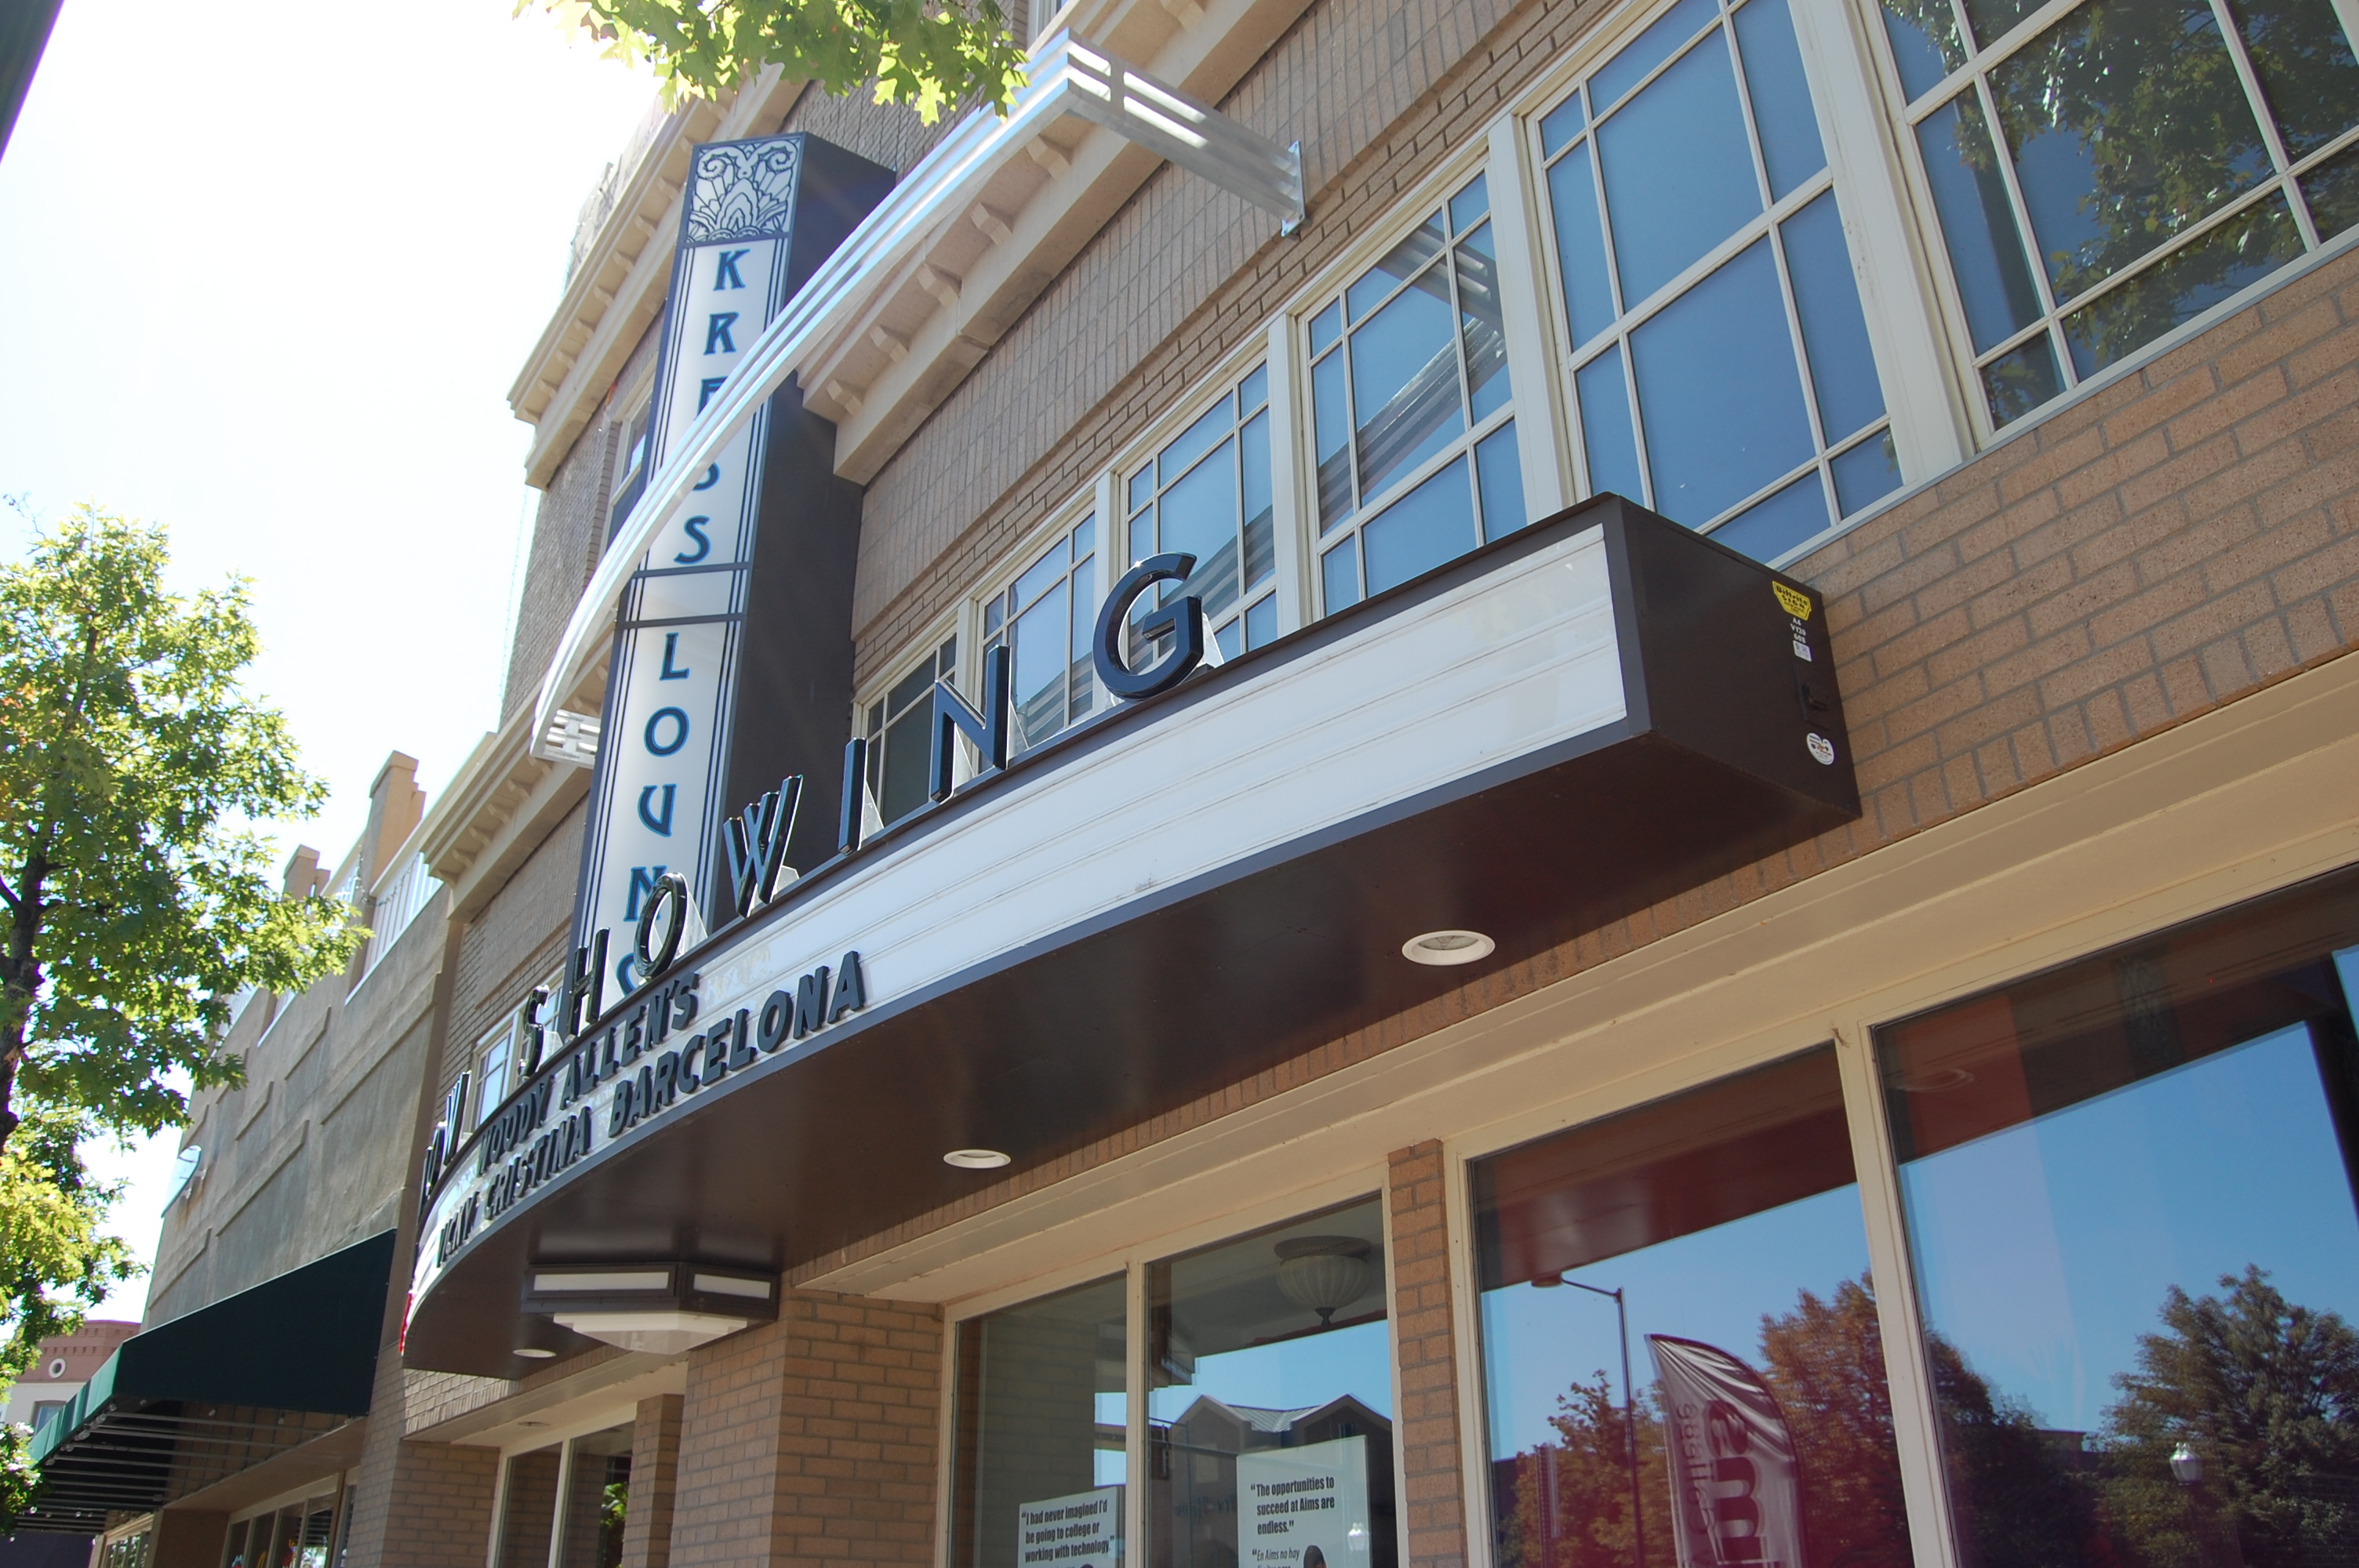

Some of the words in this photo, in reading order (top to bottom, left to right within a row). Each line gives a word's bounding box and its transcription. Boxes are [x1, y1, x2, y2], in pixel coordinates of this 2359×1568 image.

[518, 551, 1205, 1077] SHOWING
[617, 632, 690, 996] LOUN
[477, 1074, 556, 1178] WOODY
[560, 972, 700, 1111] ALLEN'S
[484, 1105, 591, 1221] CRISTINA
[608, 949, 866, 1139] BARCELONA
[1271, 1477, 1325, 1497] opportunities
[1326, 1475, 1335, 1489] to
[1030, 1510, 1044, 1525] had
[1044, 1508, 1064, 1523] never
[1065, 1501, 1098, 1519] imagined
[1257, 1500, 1289, 1516] succeed
[1290, 1498, 1299, 1512] at
[1299, 1497, 1320, 1512] Aims
[1321, 1497, 1335, 1509] are
[1025, 1531, 1034, 1544] be
[1035, 1528, 1056, 1544] going
[1056, 1527, 1064, 1540] to
[1065, 1523, 1092, 1539] college
[1092, 1522, 1100, 1534] or
[1025, 1547, 1053, 1563] working
[1055, 1544, 1070, 1559] with
[1264, 1548, 1279, 1561] Aims
[1279, 1550, 1288, 1560] no
[1289, 1545, 1300, 1562] hay
